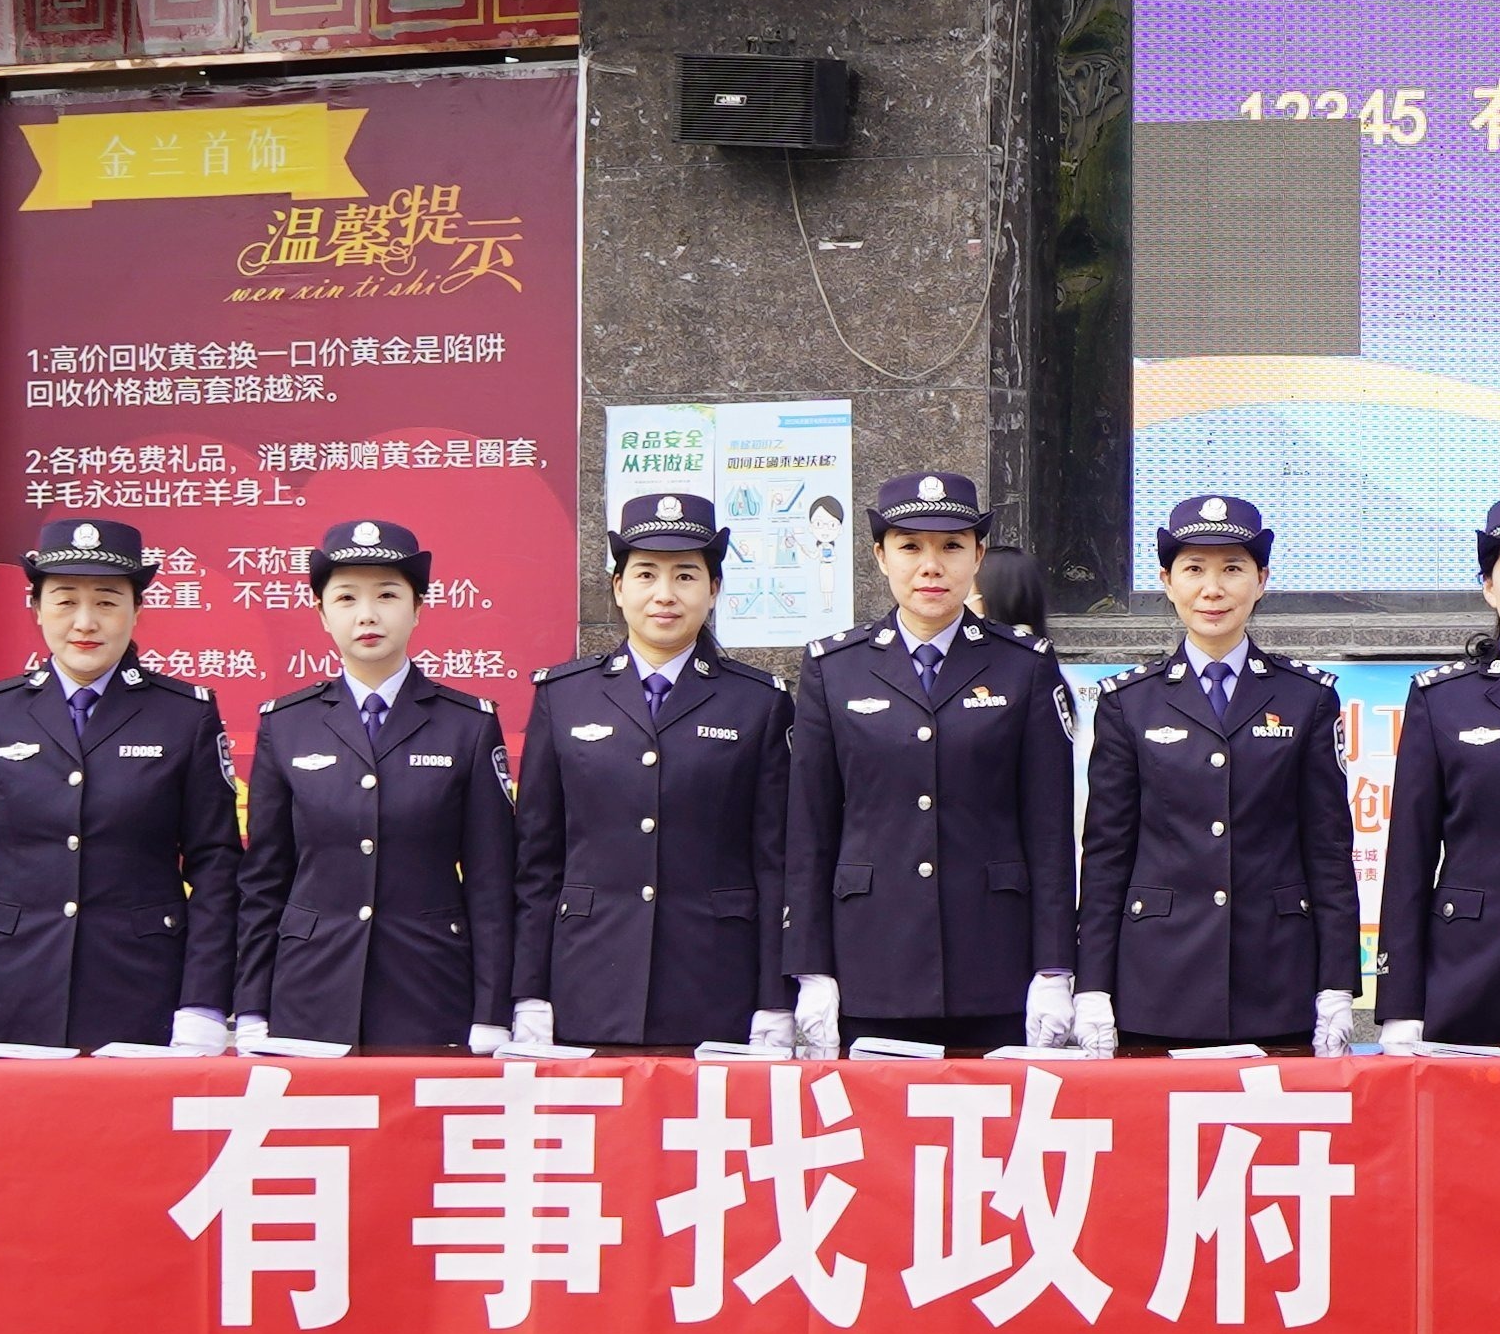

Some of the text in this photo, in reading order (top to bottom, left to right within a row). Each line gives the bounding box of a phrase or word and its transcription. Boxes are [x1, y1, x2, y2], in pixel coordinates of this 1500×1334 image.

[98, 126, 287, 181] 金兰首饰
[237, 183, 523, 294] 温馨提示
[224, 283, 285, 304] wen
[290, 276, 343, 302] xin
[27, 332, 506, 374] 1:高价回收黄金换一口价黄金是陷阱
[26, 375, 340, 409] 回收价格越高套路越深。
[621, 429, 704, 450] 食品安全
[622, 453, 704, 473] 从我做起
[25, 478, 308, 509] 羊毛永远出在羊身上。
[167, 1064, 1354, 1331] 有事找政府
